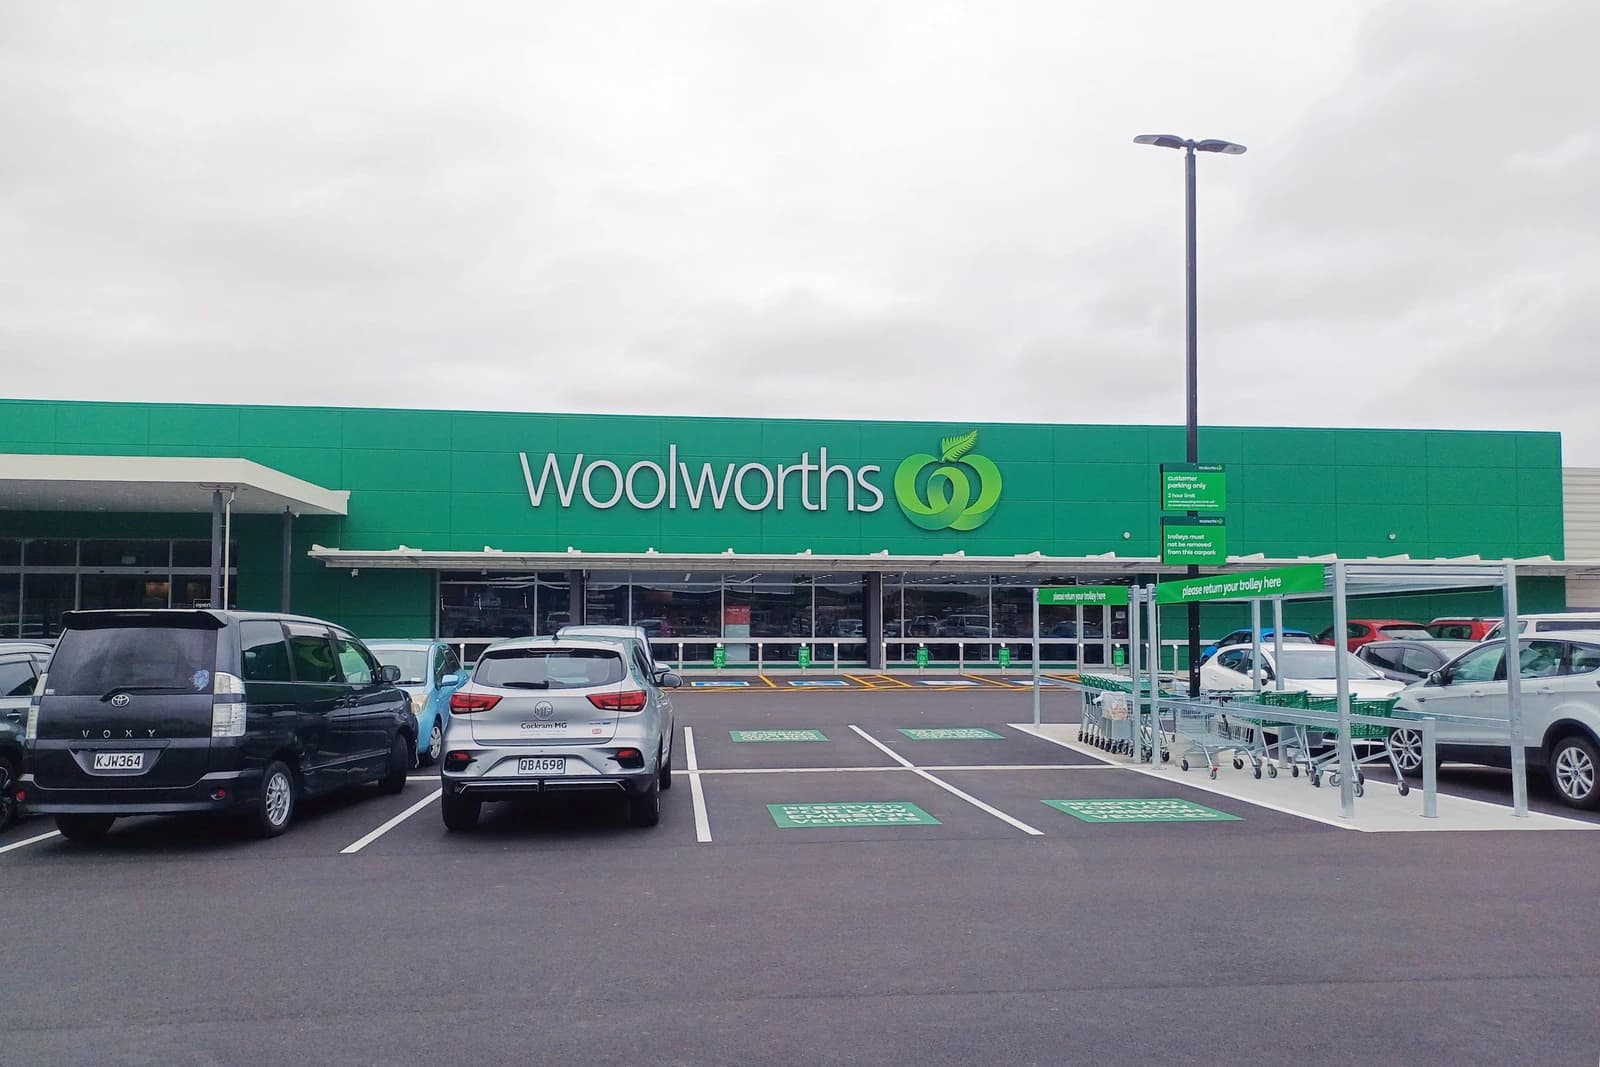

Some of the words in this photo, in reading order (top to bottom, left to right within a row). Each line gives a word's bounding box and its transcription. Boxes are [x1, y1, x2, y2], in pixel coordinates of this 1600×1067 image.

[519, 444, 884, 512] Woolworths
[1167, 482, 1192, 490] parking
[1192, 482, 1206, 490] only
[1167, 533, 1189, 541] trolleys
[1182, 585, 1203, 599] please
[1203, 583, 1223, 595] return
[1223, 582, 1238, 596] your
[1239, 577, 1263, 592] trolley
[1263, 576, 1282, 589] here
[82, 729, 156, 738] VOXY
[96, 755, 141, 767] KJW364
[520, 759, 564, 771] QBA690
